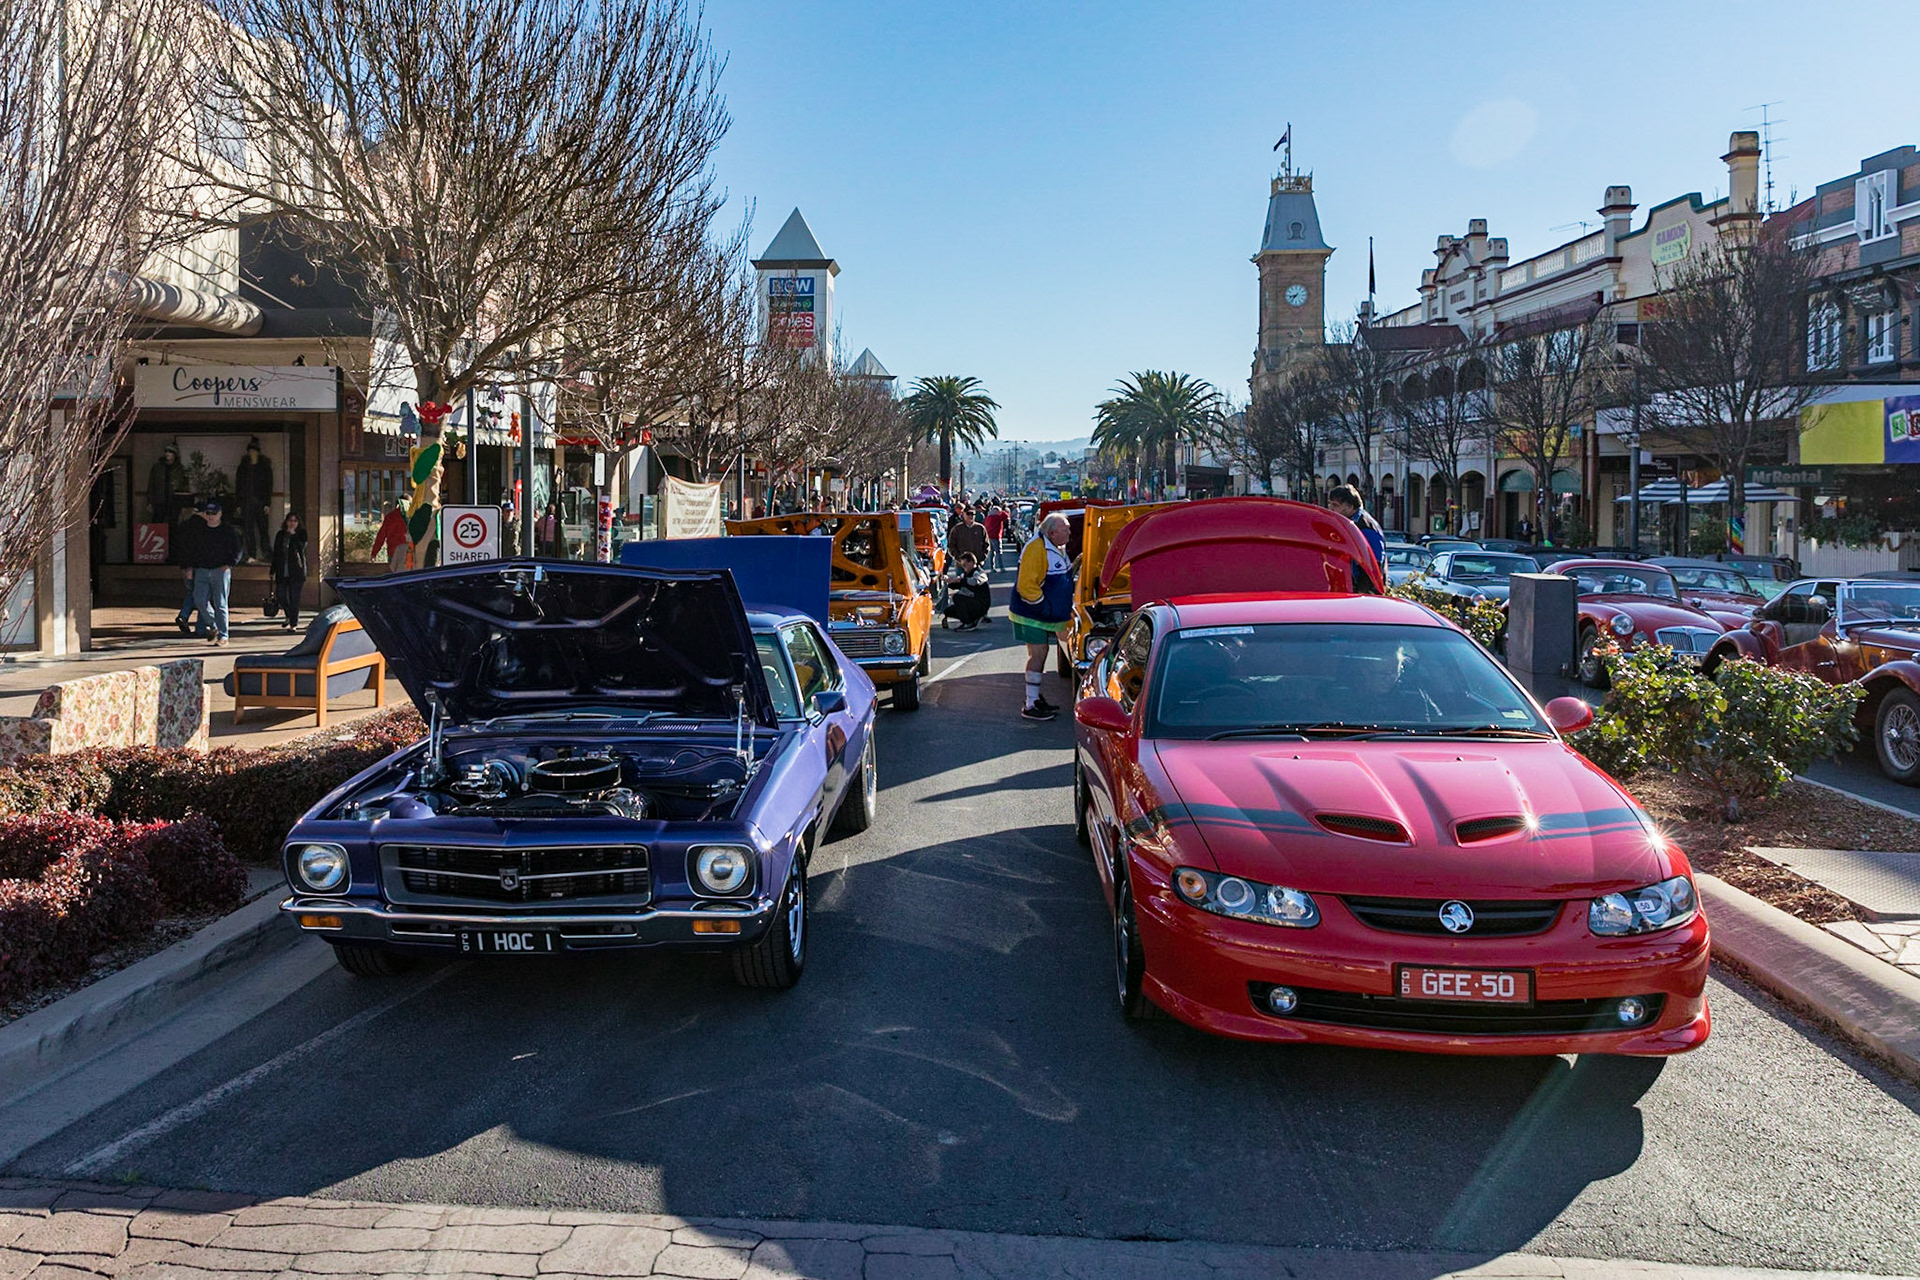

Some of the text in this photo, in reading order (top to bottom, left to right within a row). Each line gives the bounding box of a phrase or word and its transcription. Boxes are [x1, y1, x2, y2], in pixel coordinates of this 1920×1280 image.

[173, 366, 263, 405] Coopers
[224, 397, 297, 408] MENSWEAR
[459, 523, 481, 539] 25
[449, 551, 491, 562] SHARED
[493, 932, 535, 951] HQC
[1401, 971, 1411, 994] QLD
